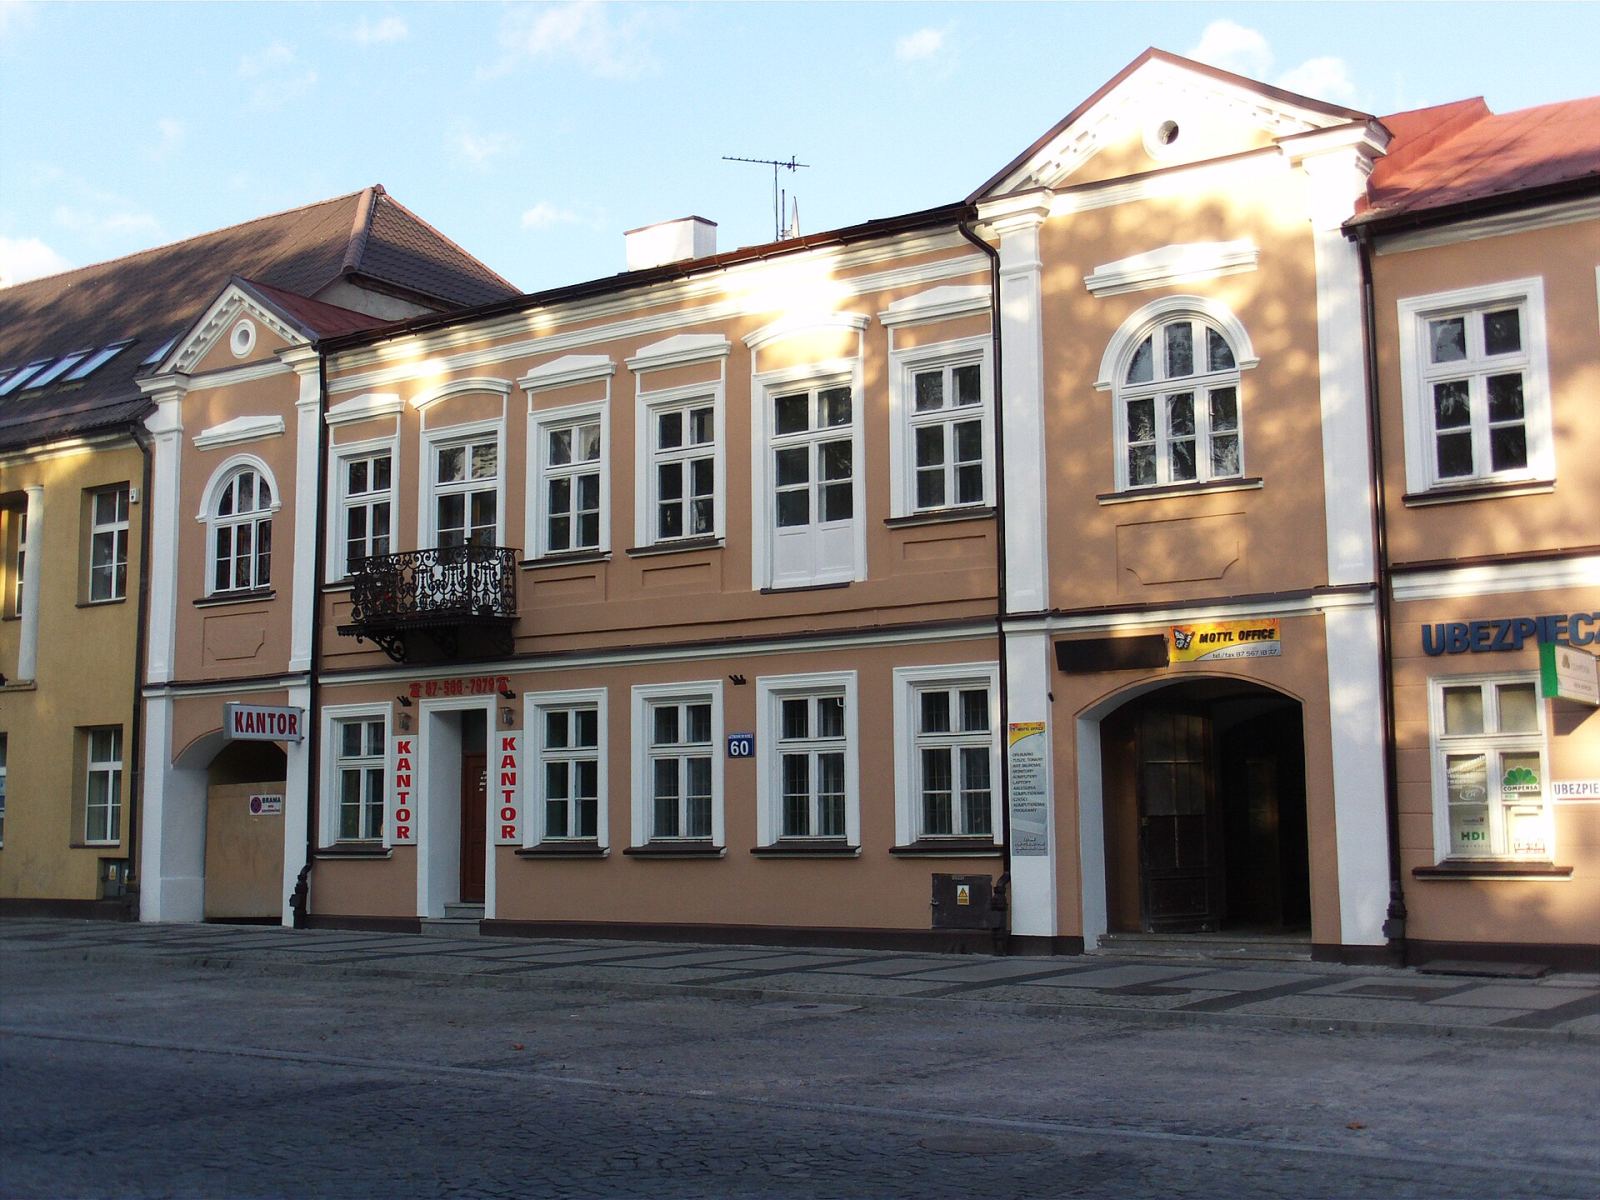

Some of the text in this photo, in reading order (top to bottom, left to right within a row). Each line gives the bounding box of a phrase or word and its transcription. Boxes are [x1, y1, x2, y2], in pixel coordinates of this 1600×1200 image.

[1199, 628, 1275, 643] MOTYL OFFICE
[235, 711, 297, 735] KANTOR
[730, 740, 749, 756] 60
[396, 740, 412, 839] KANTOR
[501, 737, 517, 839] KANTOR
[1553, 783, 1599, 795] UBEZPIE
[1461, 831, 1485, 841] HDI
